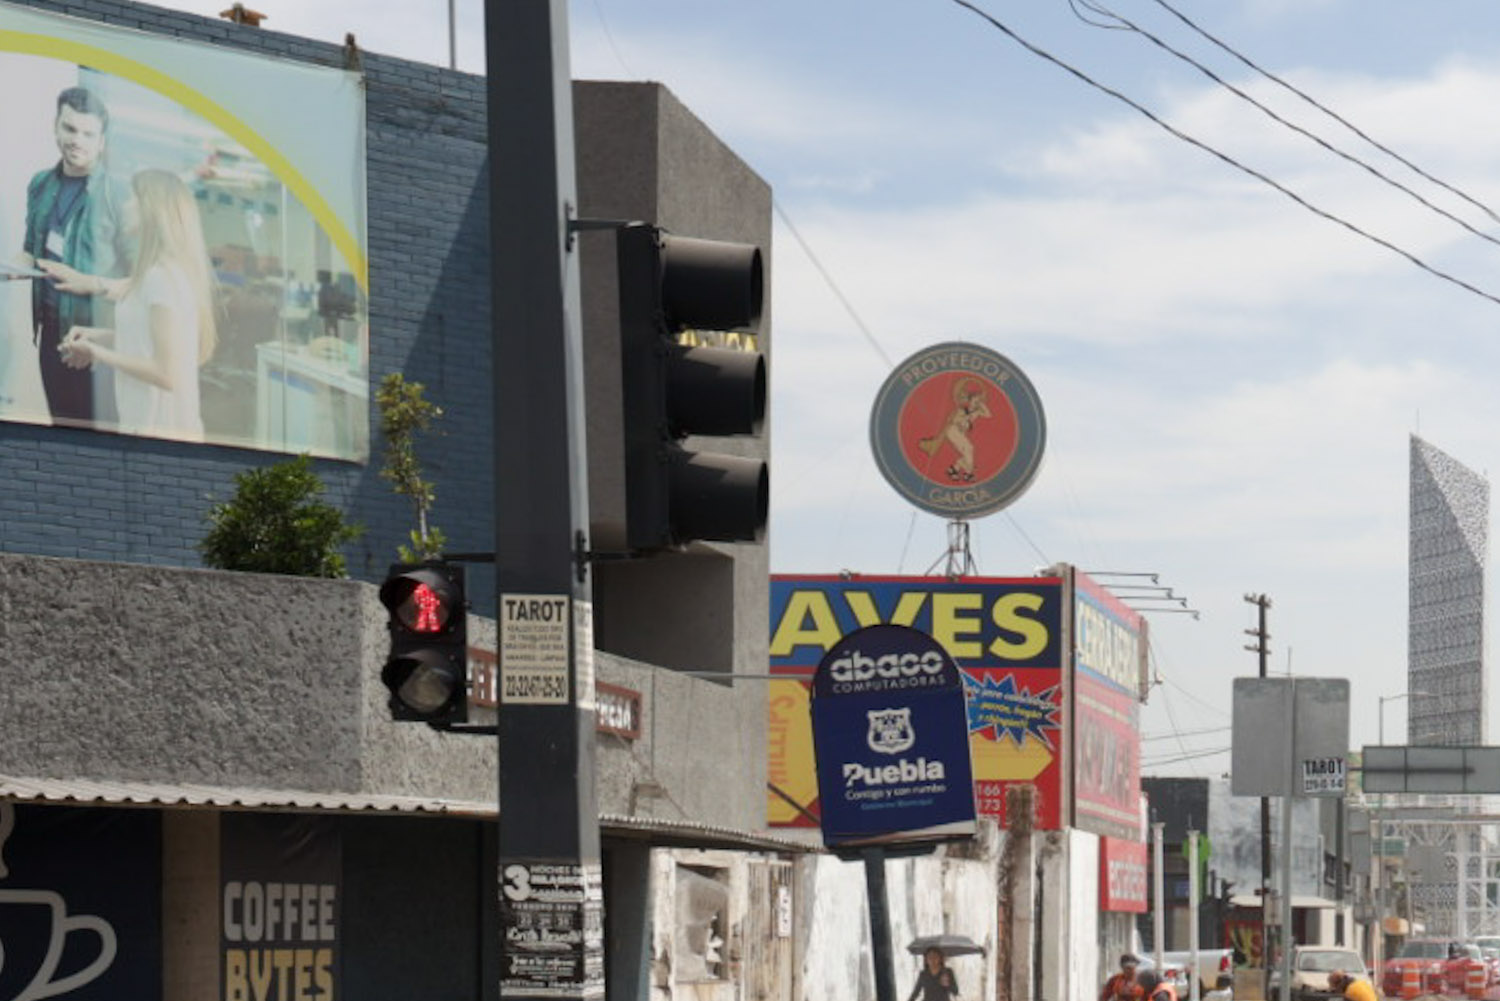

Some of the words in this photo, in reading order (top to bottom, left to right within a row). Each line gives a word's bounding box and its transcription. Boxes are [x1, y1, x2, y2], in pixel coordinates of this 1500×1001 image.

[901, 352, 1012, 386] PROVEEDOR
[505, 600, 565, 622] TAROT
[832, 674, 947, 694] COMPUTADORAS
[842, 757, 945, 788] Puebla
[1305, 757, 1344, 775] TAROT
[503, 864, 530, 901] 3
[223, 881, 337, 942] COFFEE
